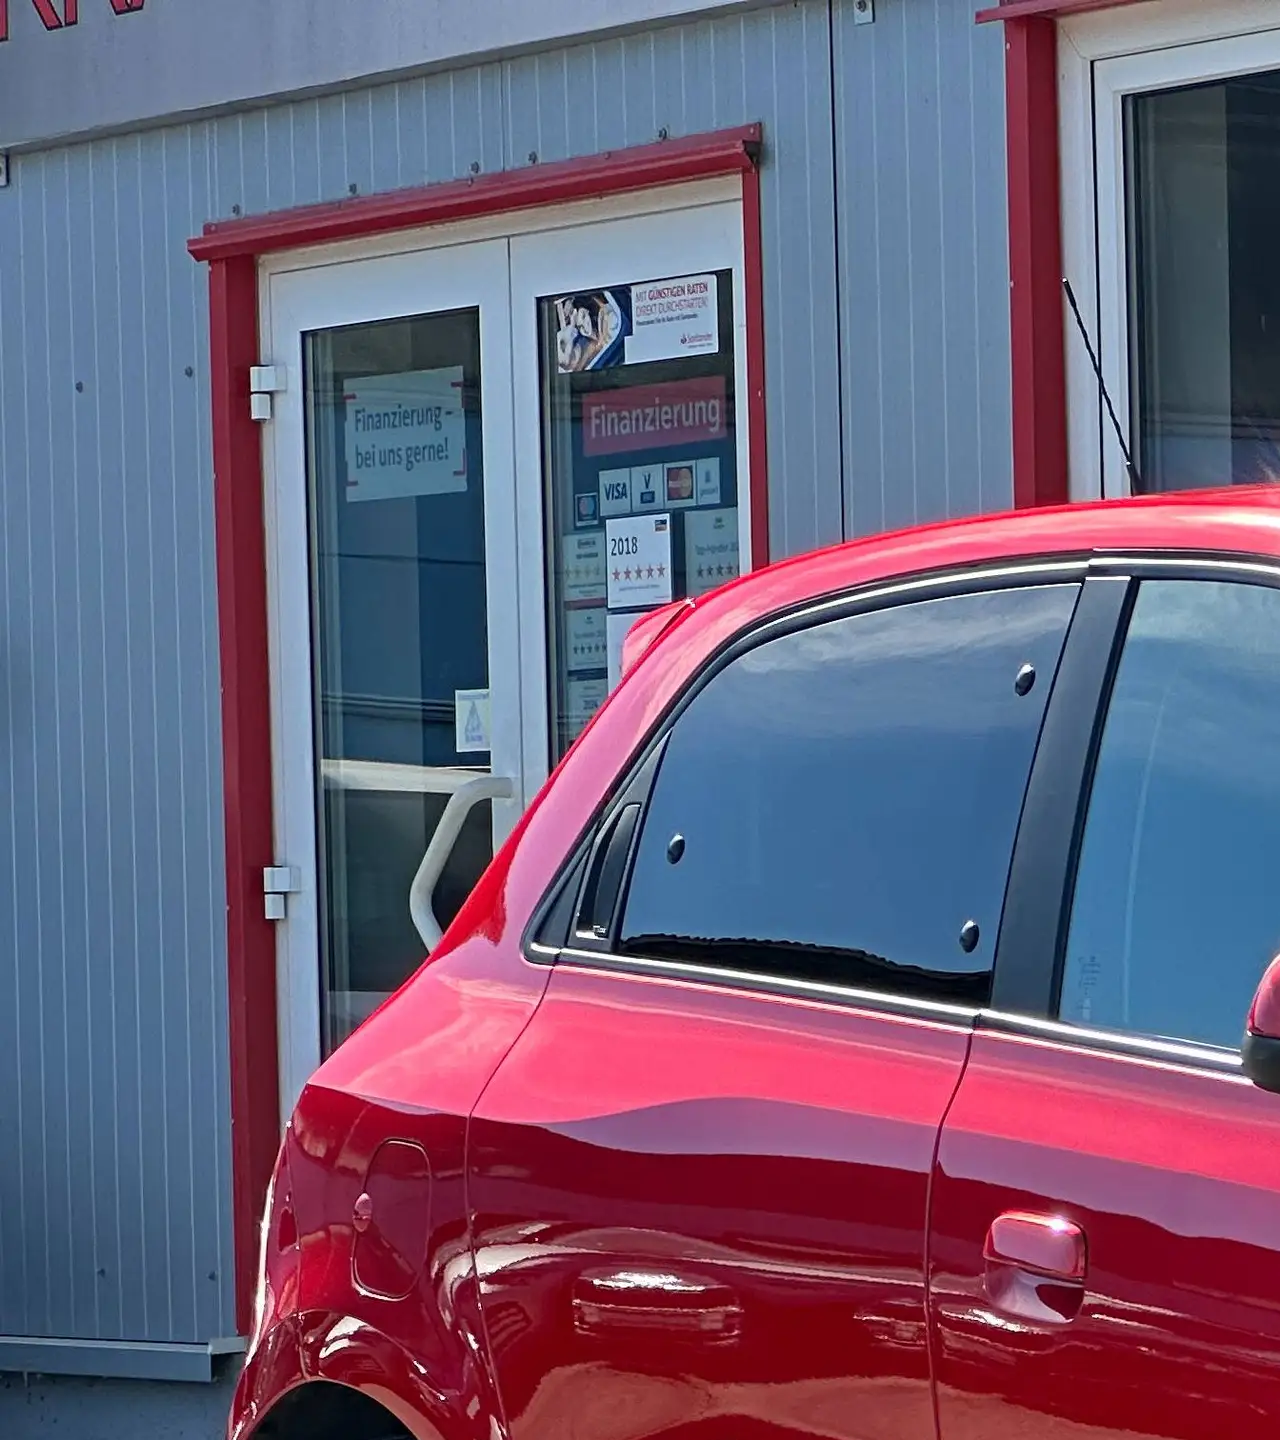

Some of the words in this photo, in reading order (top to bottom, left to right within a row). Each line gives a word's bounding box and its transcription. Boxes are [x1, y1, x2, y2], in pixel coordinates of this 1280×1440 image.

[354, 404, 443, 432] Finanzierung
[590, 397, 720, 440] Finanzierung
[356, 443, 376, 469] bei
[378, 446, 403, 467] uns
[405, 438, 448, 471] gerne!
[604, 482, 628, 502] VISA
[610, 536, 639, 557] 2018
